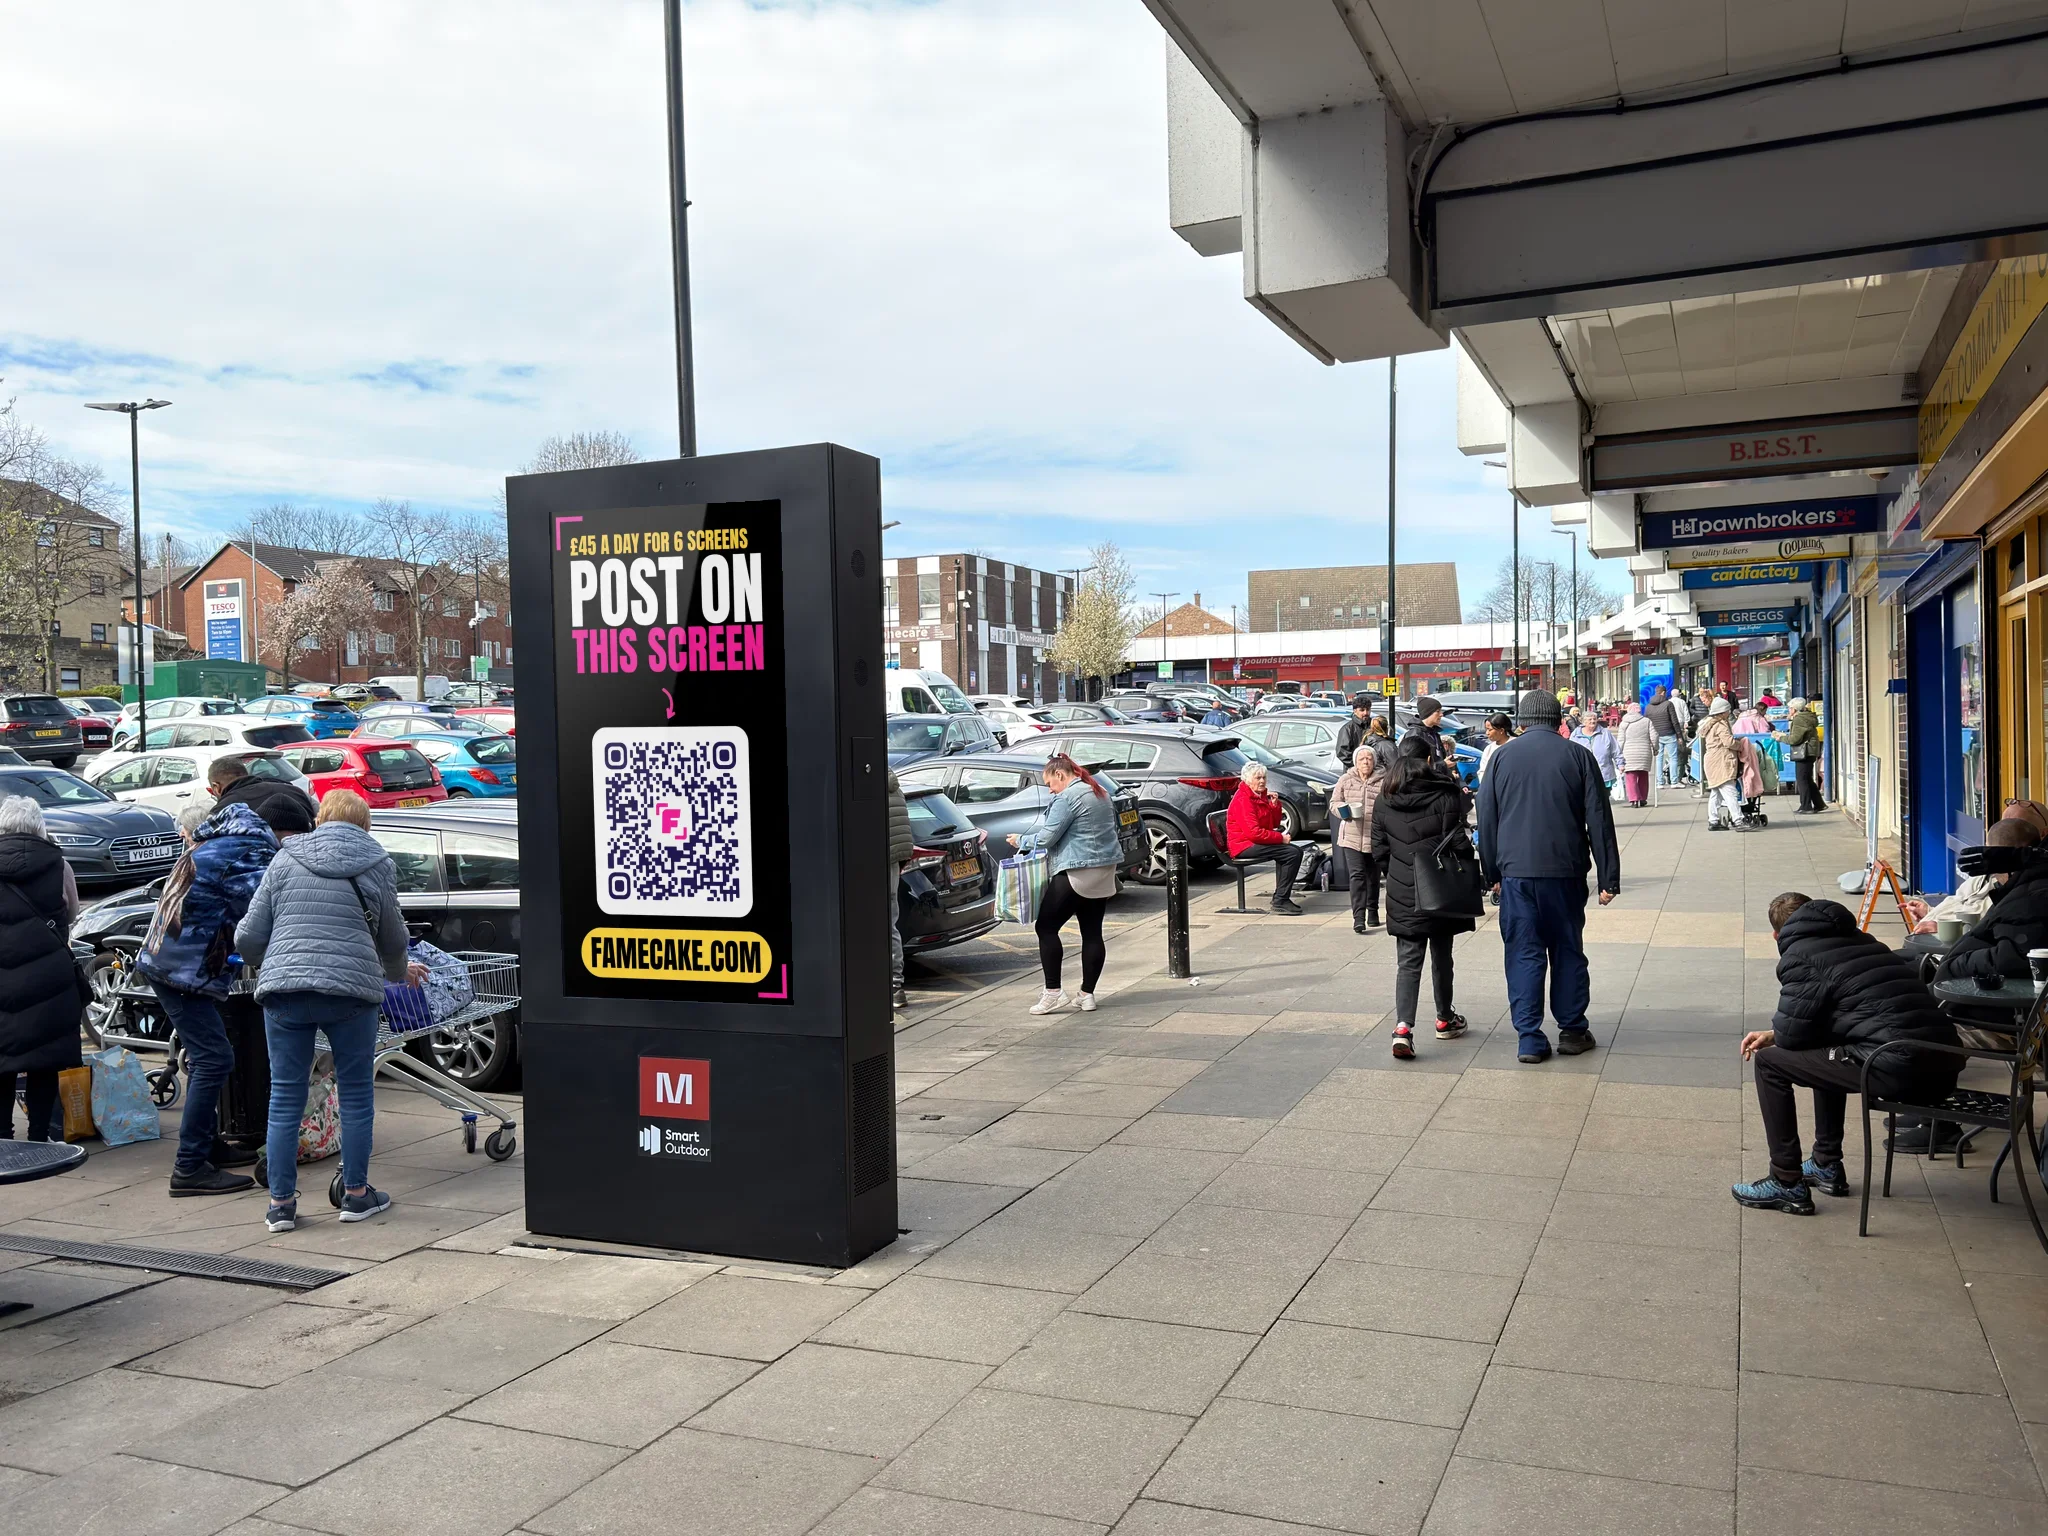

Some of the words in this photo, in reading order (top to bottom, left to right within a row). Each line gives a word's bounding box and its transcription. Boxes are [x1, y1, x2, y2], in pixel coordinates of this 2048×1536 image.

[1958, 256, 2028, 405] COMMUNITY
[1729, 434, 1823, 461] B.E.S.T.
[1700, 510, 1836, 536] pawnbrokers
[570, 535, 597, 556] £45
[600, 534, 610, 555] A
[613, 533, 640, 554] DAY
[644, 531, 670, 553] FOR
[673, 530, 683, 552] 6
[687, 528, 748, 550] SCREENS
[1691, 548, 1722, 560] Quality
[1722, 547, 1749, 556] Bakers
[1711, 564, 1799, 582] cardfactory
[570, 556, 684, 627] POST
[700, 552, 764, 625] ON
[211, 602, 236, 611] TESCO
[1731, 610, 1784, 622] GREGGS
[571, 628, 638, 674] THIS
[648, 624, 764, 673] SCREEN
[1399, 649, 1475, 661] poundstretcher
[1244, 655, 1316, 666] poundstretcher
[1385, 678, 1397, 693] H
[133, 849, 154, 860] YV68
[154, 847, 170, 857] LLJ
[591, 936, 761, 973] FAMECAKE.COM
[656, 1071, 693, 1105] M
[665, 1129, 700, 1143] Smart
[665, 1143, 710, 1157] Outdoor
